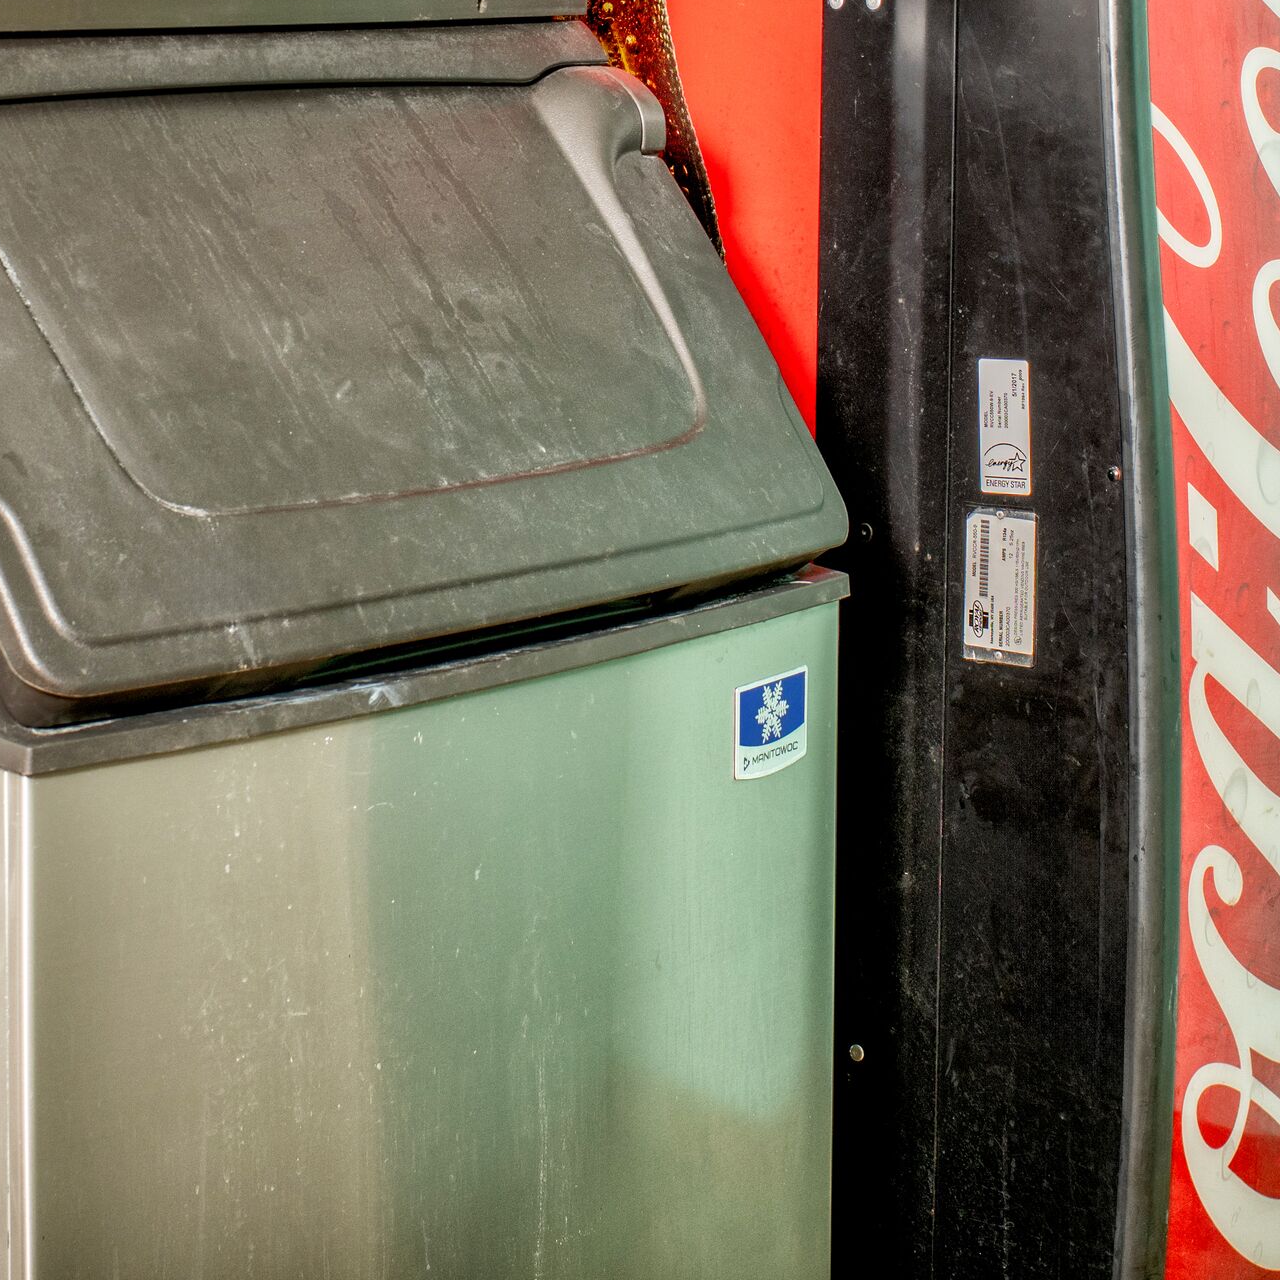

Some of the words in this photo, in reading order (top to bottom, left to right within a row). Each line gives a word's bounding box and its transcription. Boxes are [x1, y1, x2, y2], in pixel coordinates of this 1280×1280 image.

[986, 478, 1010, 488] ENERGY
[1010, 480, 1026, 489] STAR
[751, 740, 799, 766] MANITOWOC
